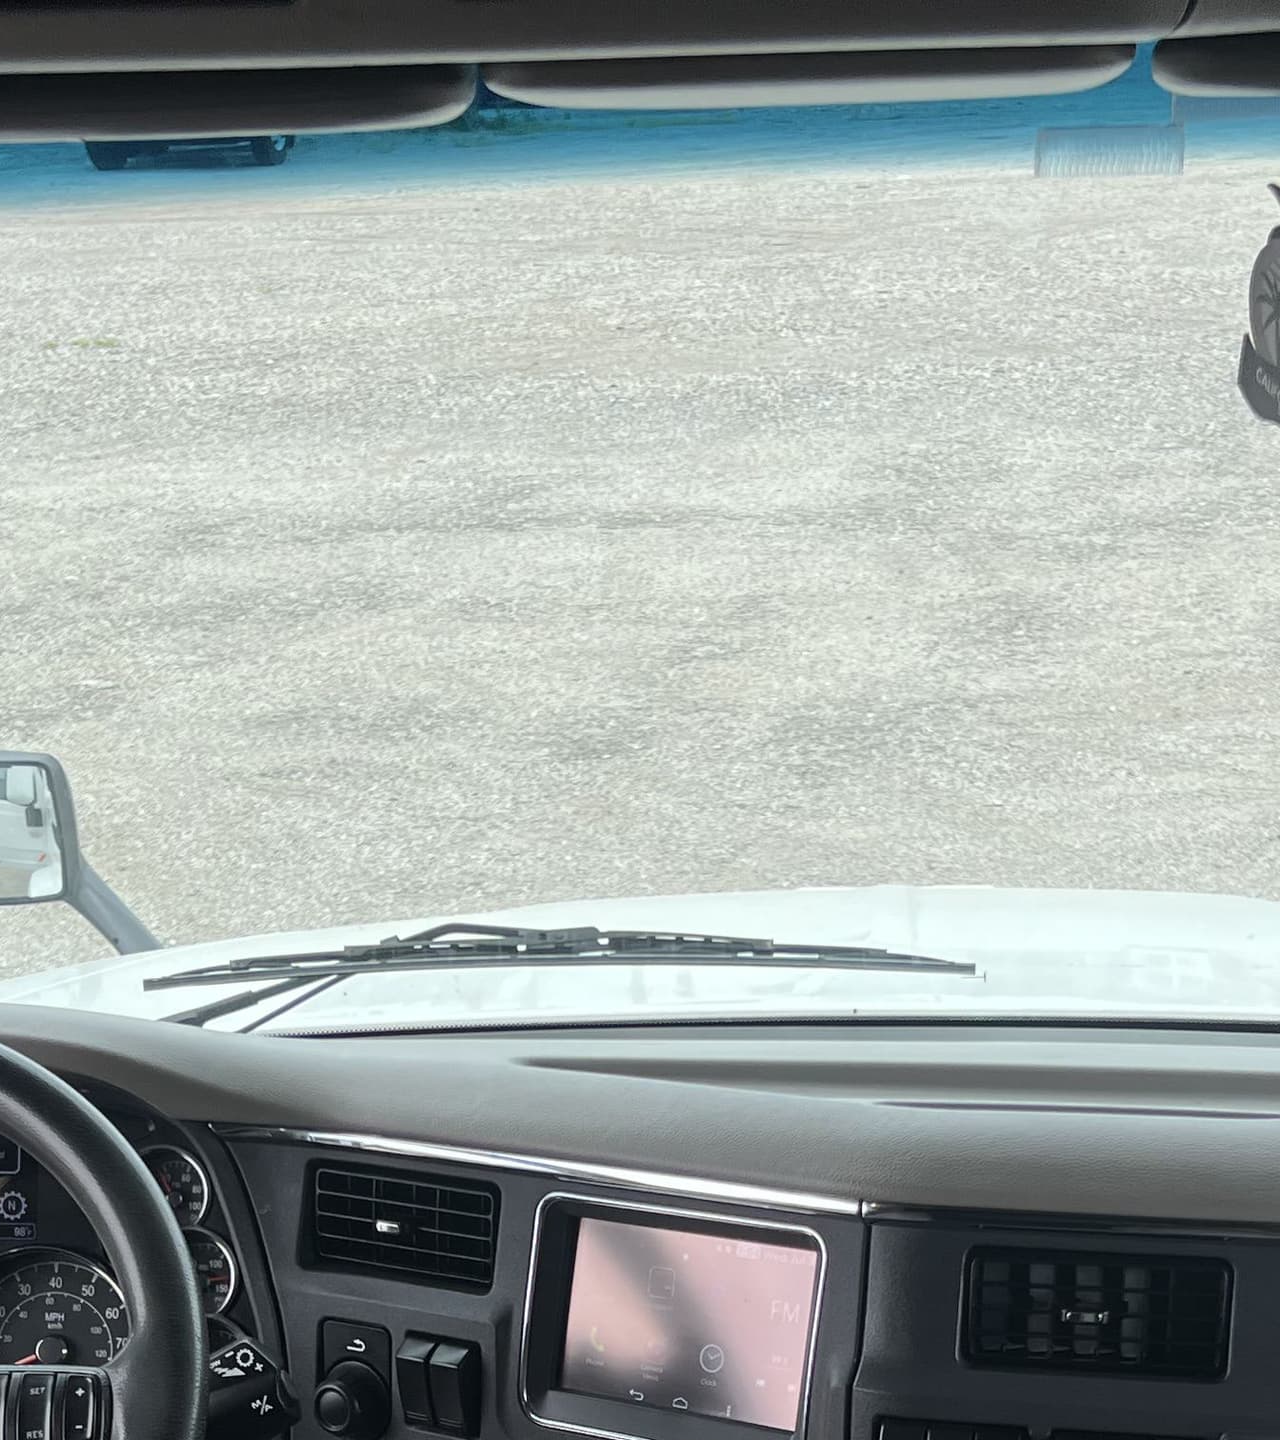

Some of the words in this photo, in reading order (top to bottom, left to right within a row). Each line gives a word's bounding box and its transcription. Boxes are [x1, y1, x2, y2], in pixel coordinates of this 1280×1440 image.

[49, 1277, 62, 1288] 40
[18, 1284, 31, 1295] 30
[81, 1285, 95, 1297] 50
[105, 1307, 119, 1319] 60
[771, 1300, 800, 1323] FM
[45, 1313, 65, 1322] MPH
[30, 1387, 45, 1396] SET
[26, 1431, 44, 1440] RES
